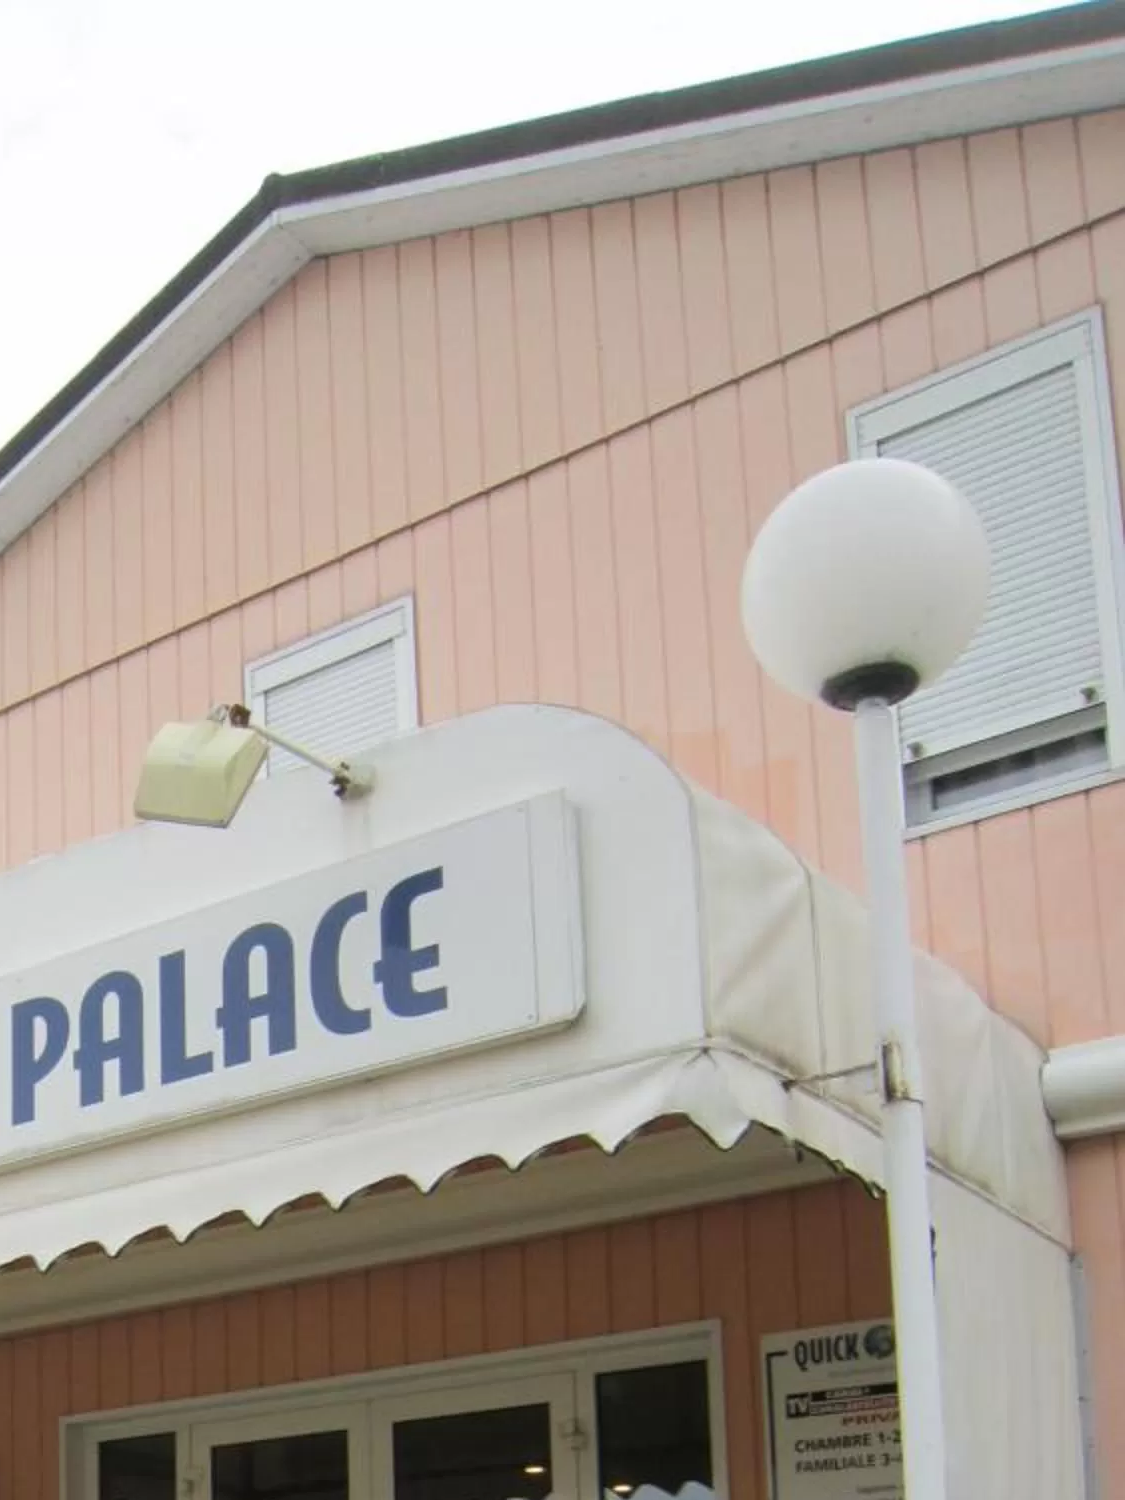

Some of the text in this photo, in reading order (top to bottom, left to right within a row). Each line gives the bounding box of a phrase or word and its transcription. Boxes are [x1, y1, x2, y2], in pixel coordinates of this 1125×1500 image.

[11, 865, 448, 1126] PALACE
[794, 1332, 860, 1371] QUICK
[794, 1432, 872, 1453] CHAMBRE
[795, 1453, 876, 1474] FAMILIALE
